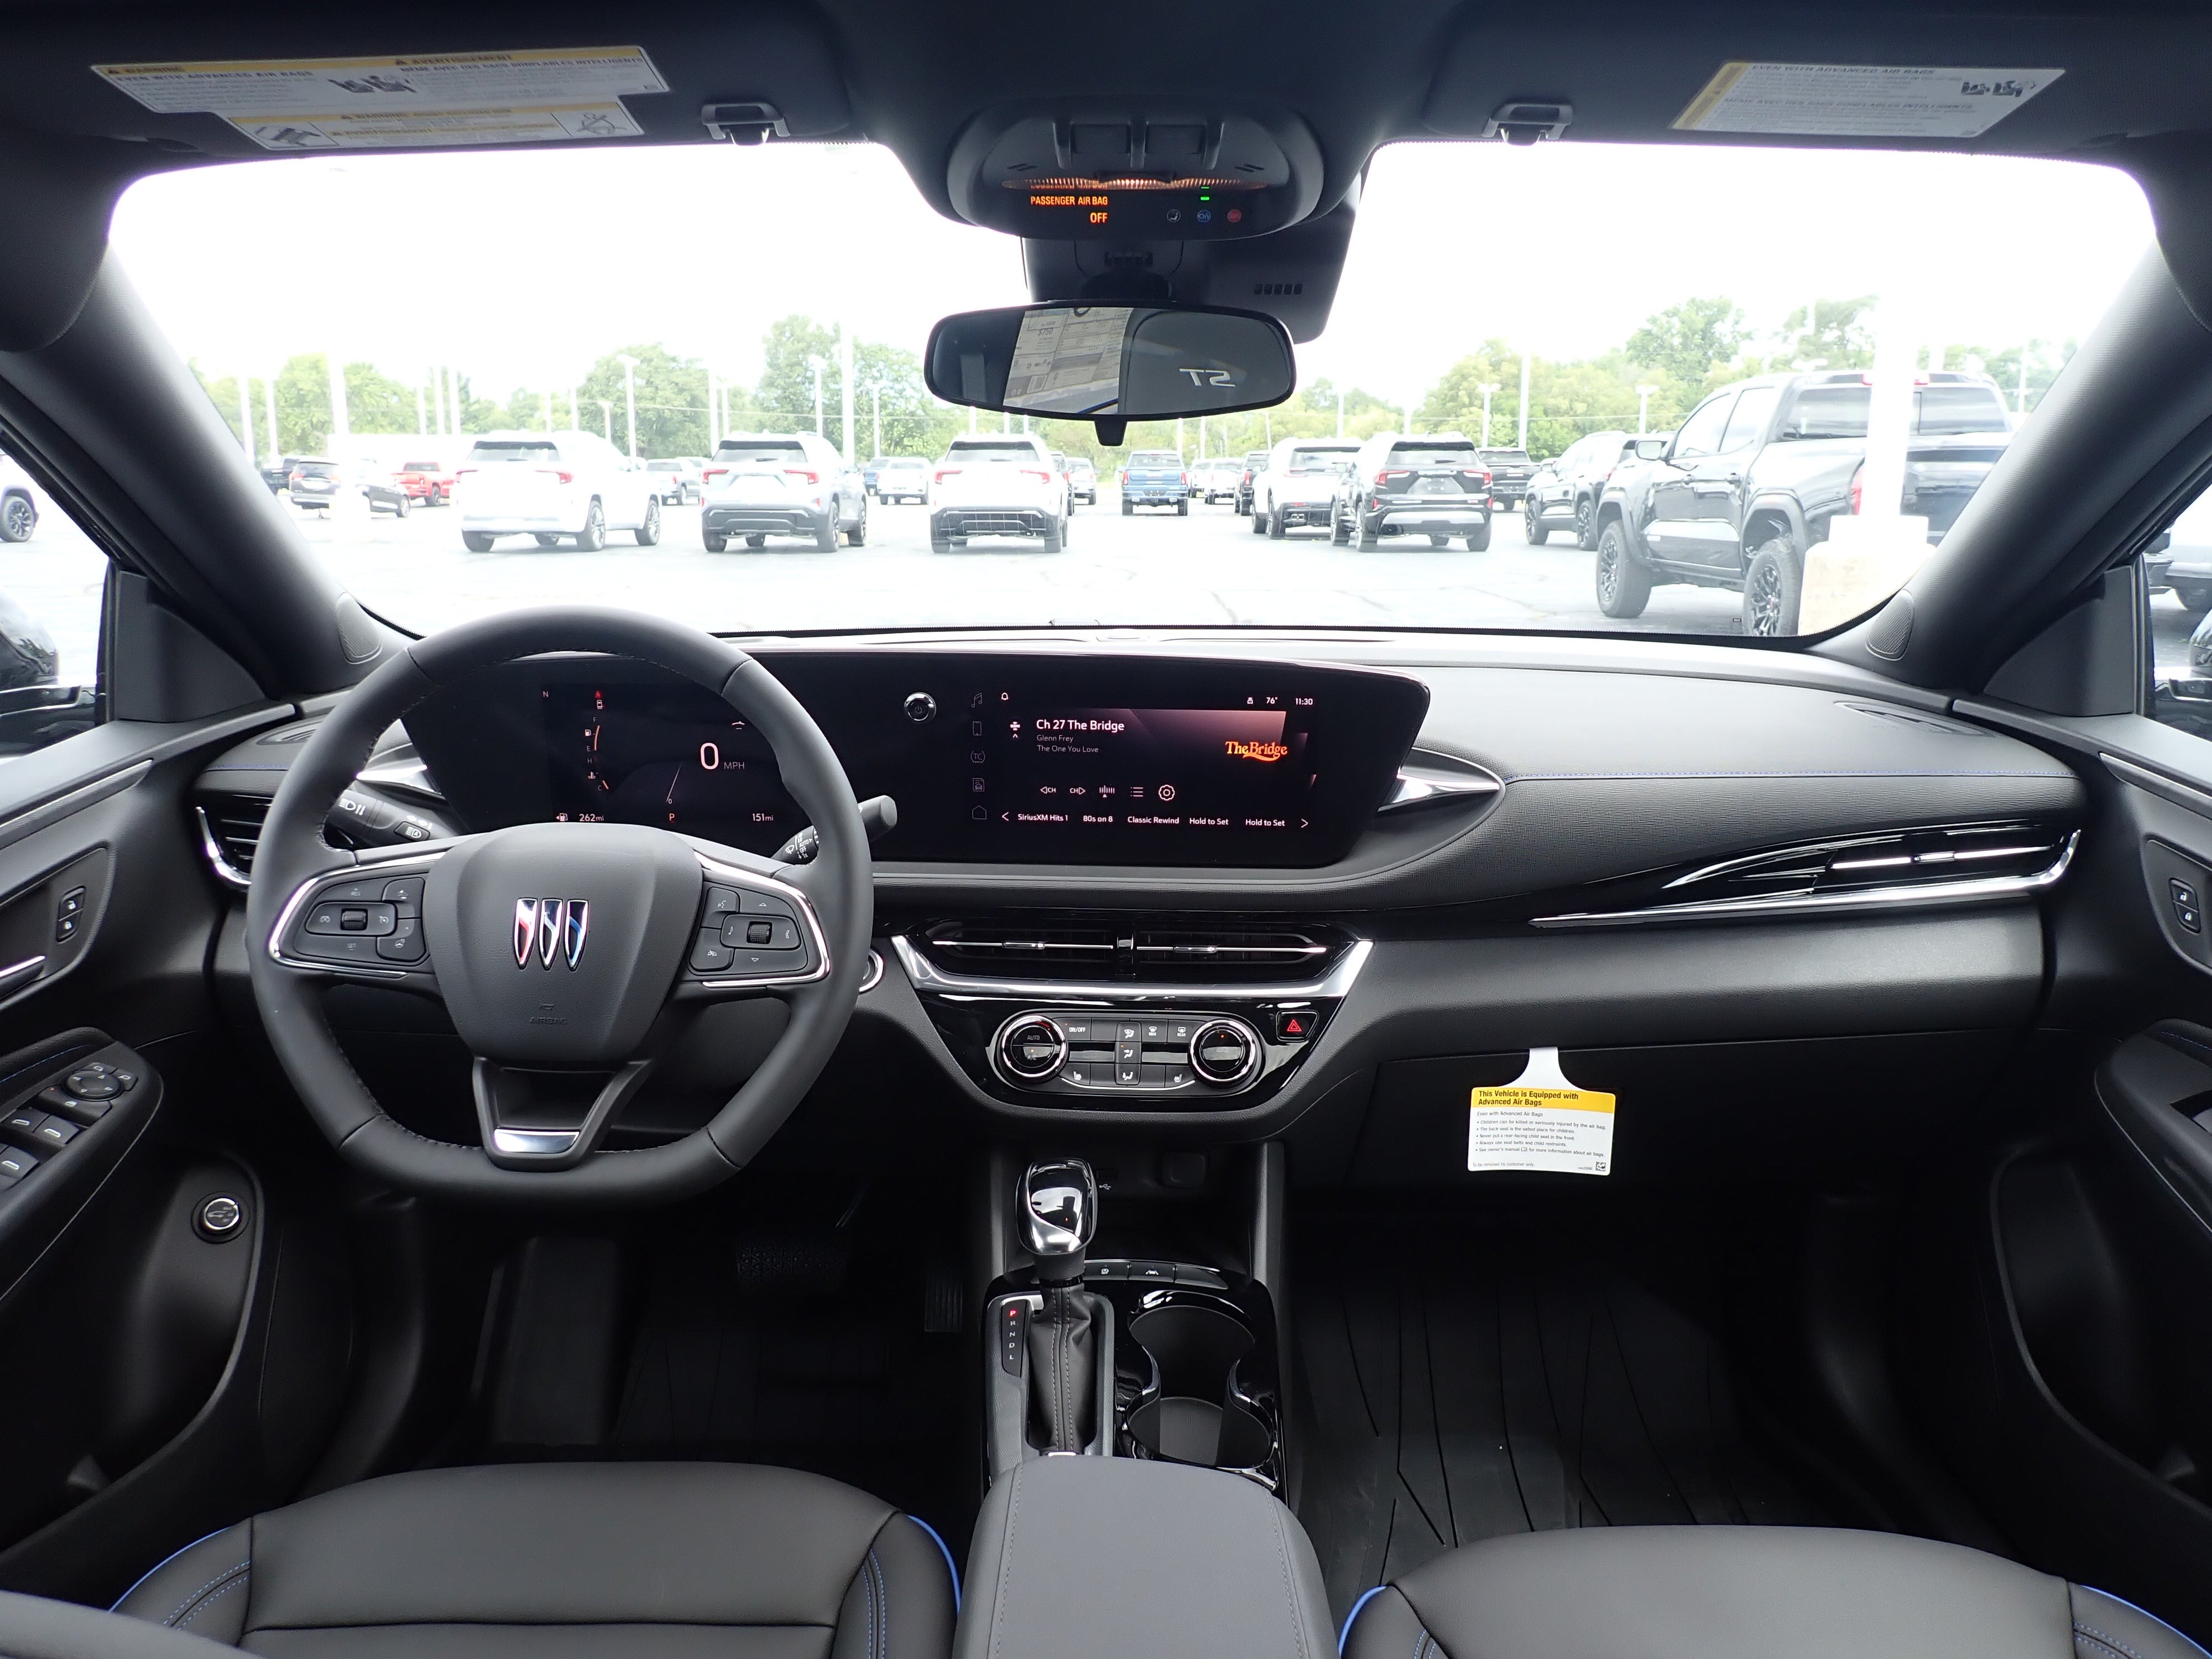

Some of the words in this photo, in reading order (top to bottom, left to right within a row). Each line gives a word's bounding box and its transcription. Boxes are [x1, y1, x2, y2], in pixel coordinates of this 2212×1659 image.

[1030, 196, 1075, 205] PASSENGER
[1078, 196, 1091, 205] AIR
[1092, 196, 1108, 205] BAG
[1090, 212, 1108, 223] OFF
[1036, 719, 1051, 729] Ch
[1052, 719, 1066, 729] 27
[1067, 719, 1088, 730] The
[1090, 720, 1125, 733] Bridge
[1058, 734, 1074, 743] Frey
[700, 742, 719, 770] 0
[723, 761, 745, 770] MPH
[669, 813, 675, 821] P
[799, 839, 810, 848] AUTO
[1529, 1091, 1561, 1099] Equipped
